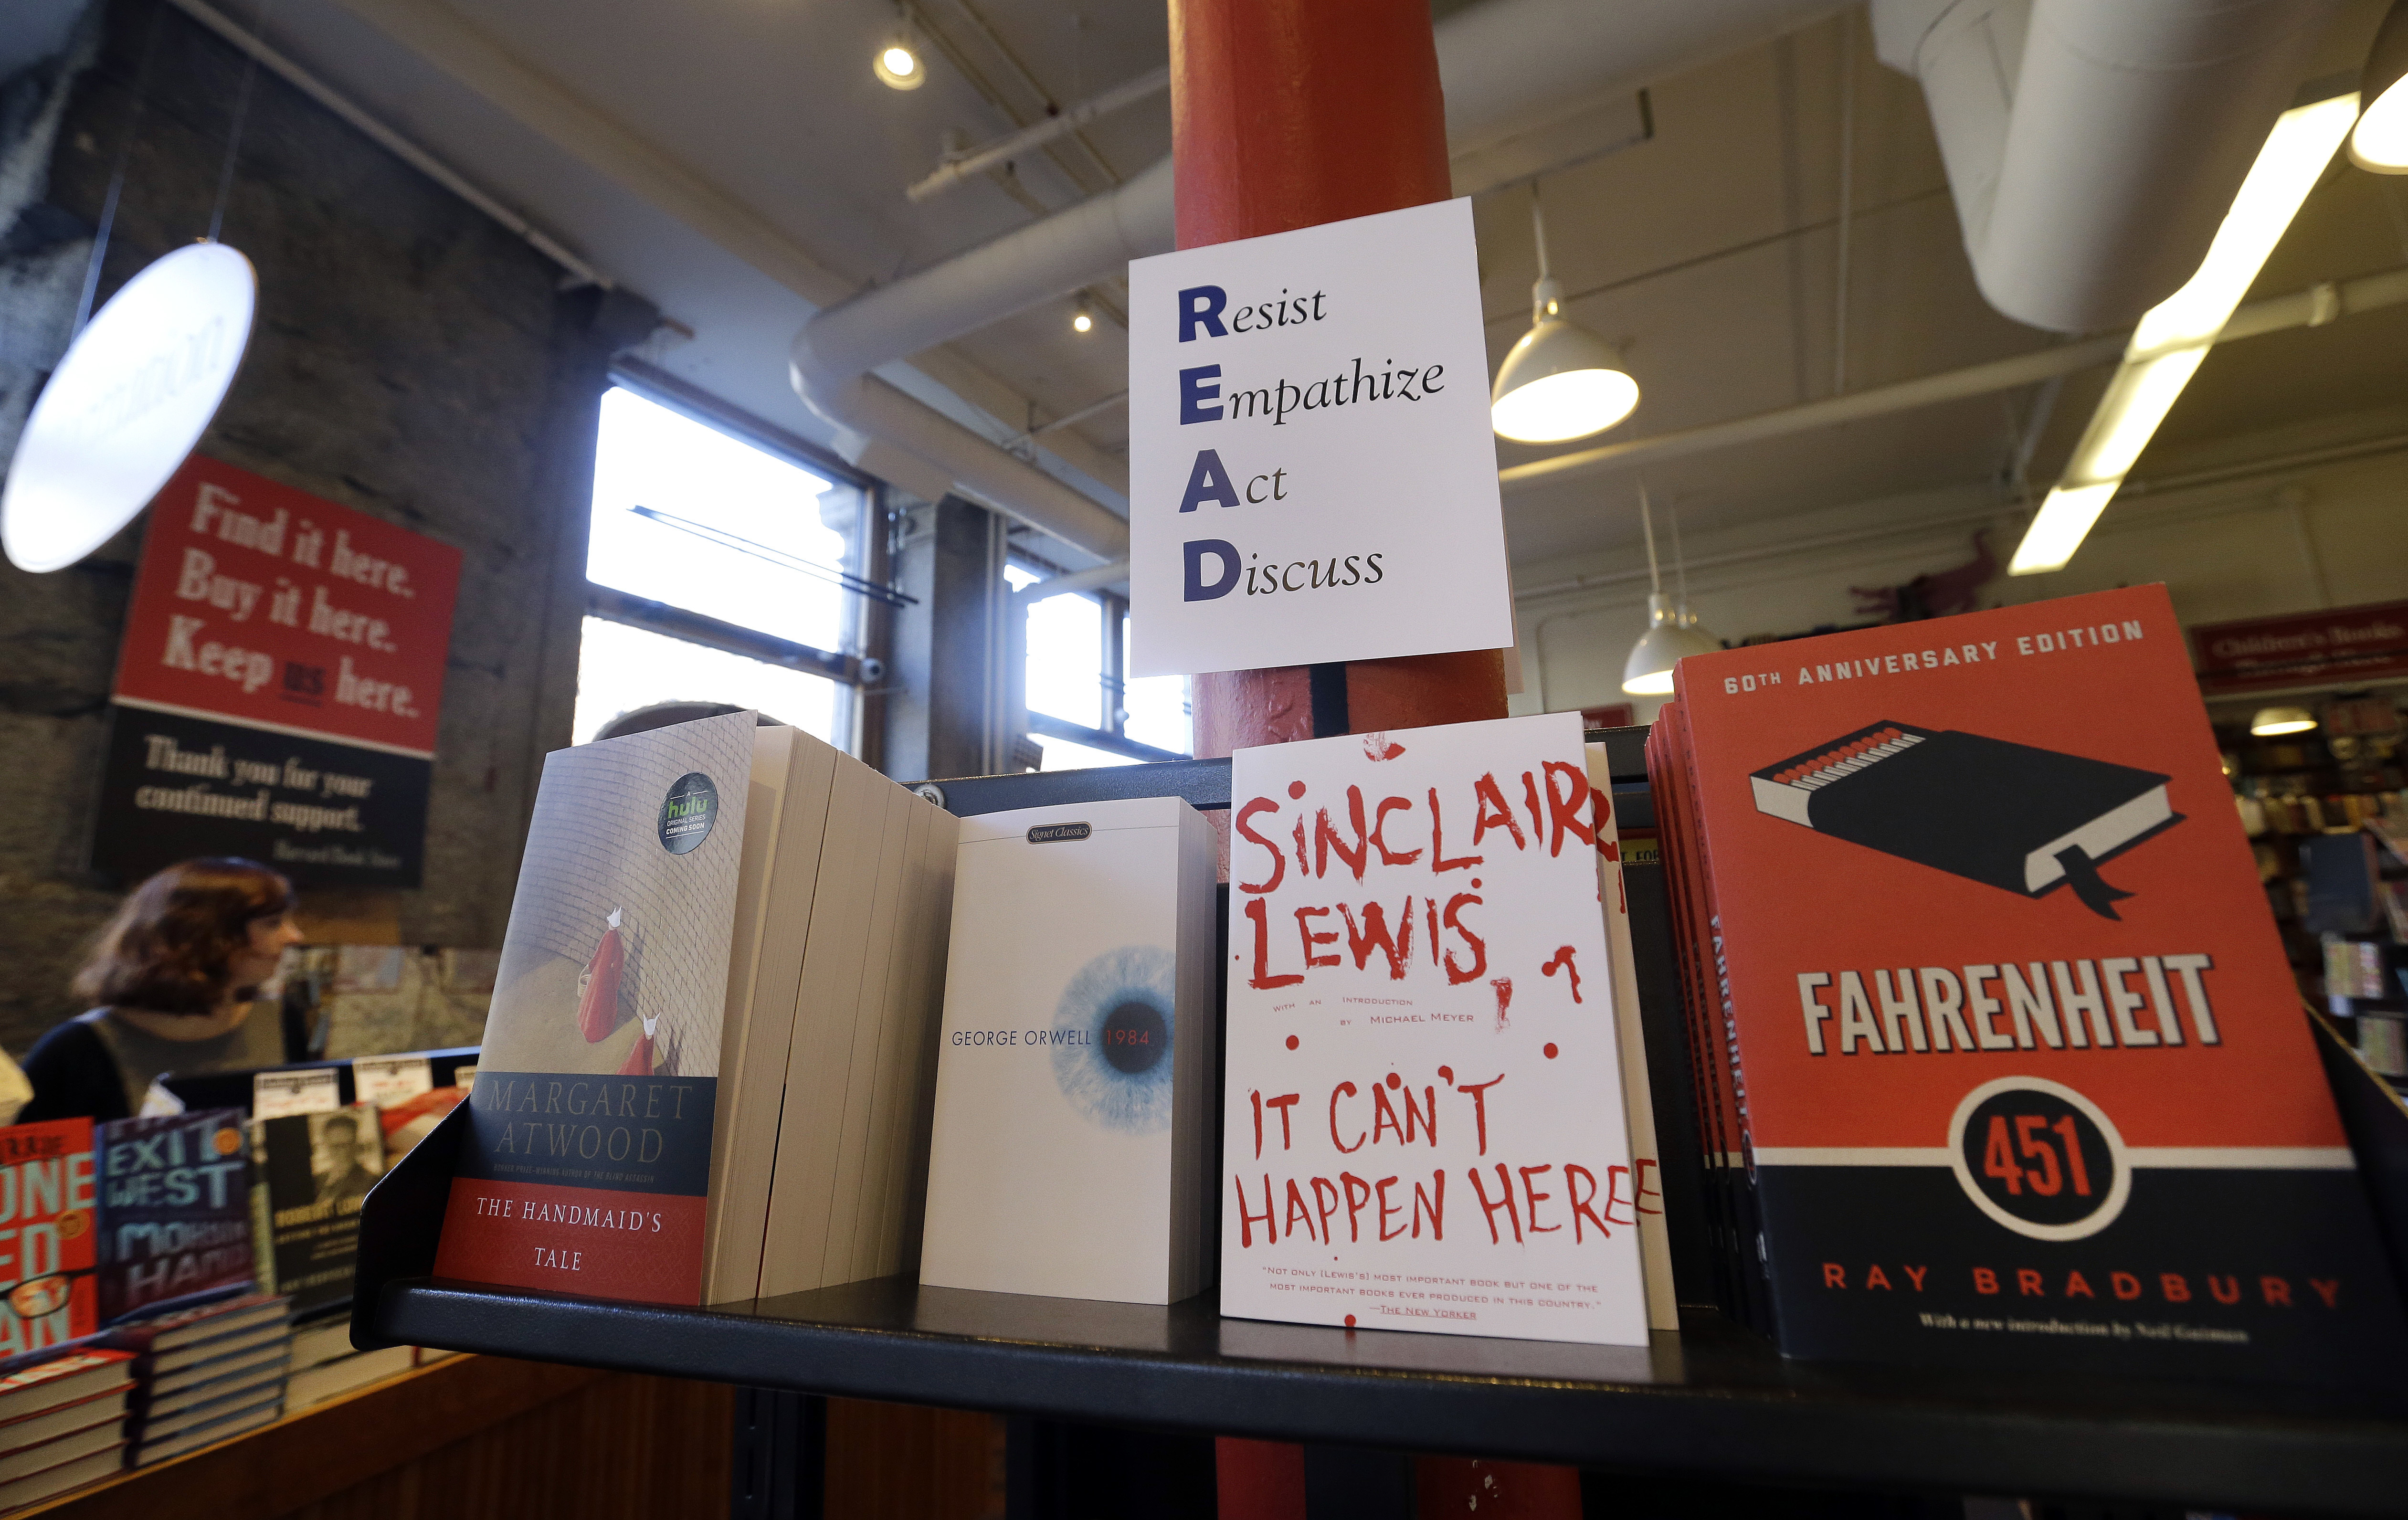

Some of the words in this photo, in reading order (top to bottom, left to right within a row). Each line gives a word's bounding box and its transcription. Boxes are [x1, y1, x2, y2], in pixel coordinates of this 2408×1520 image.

[1178, 284, 1328, 343] Resist
[1179, 358, 1446, 426] Empathize
[1179, 448, 1288, 513] Act
[191, 482, 289, 556] Find
[292, 520, 323, 569] it
[331, 530, 416, 599] here.
[1183, 538, 1384, 602] Discuss
[176, 547, 263, 622] Buy
[270, 577, 301, 628] it
[309, 586, 397, 654] here.
[162, 614, 274, 694] Keep
[336, 655, 421, 718] here.
[1724, 671, 1782, 695] 60TH
[1798, 641, 1998, 686] ANNIVERSARY
[2018, 620, 2144, 656] EDITION
[145, 734, 229, 779] Thank
[230, 757, 281, 786] you
[283, 757, 318, 791] for
[321, 772, 374, 800] your
[134, 784, 270, 822] continued
[667, 818, 687, 826] ORIGINAL
[689, 814, 706, 823] SERIES
[668, 796, 708, 818] hulu
[666, 825, 687, 835] COMING
[688, 822, 705, 831] SOON
[1030, 829, 1054, 842] Signet
[1056, 826, 1089, 837] Classics
[1274, 1003, 1295, 1013] WITH
[1342, 997, 1413, 1006] INTRODUCTION
[1371, 1015, 1426, 1024] MICHAEL
[1431, 1013, 1474, 1022] MEYER
[1797, 954, 2222, 1056] FAHRENHEIT
[952, 1031, 1017, 1046] GEORGE
[1024, 1030, 1091, 1046] ORWELL
[1106, 1030, 1149, 1045] 1984
[488, 1079, 692, 1119] MARGARET
[1249, 1089, 1299, 1160] IT
[1330, 1066, 1505, 1156] CAN'T
[106, 1111, 239, 1176] EXIT
[494, 1123, 663, 1163] ATWOOD
[1984, 1115, 2092, 1197] 451
[106, 1161, 246, 1209] WEST
[1236, 1169, 1445, 1248] HAPPEN
[1469, 1162, 1635, 1245] HERE
[477, 1197, 513, 1217] THE
[523, 1201, 661, 1233] HANDMAID'S
[535, 1247, 581, 1271] TALE
[1406, 1276, 1465, 1285] IMPORTANT
[1470, 1279, 1500, 1288] BOOK
[1300, 1285, 1355, 1295] IMPORTANT
[1360, 1289, 1394, 1298] BOOKS
[1430, 1293, 1489, 1303] PRODUCED
[1823, 1262, 1927, 1292] RAY
[1972, 1267, 2340, 1309] BRADBURY
[1918, 1312, 1956, 1328] With
[1959, 1319, 1969, 1329] a
[1973, 1319, 2004, 1330] new
[2007, 1316, 2108, 1336] introduction
[2111, 1319, 2131, 1341] by
